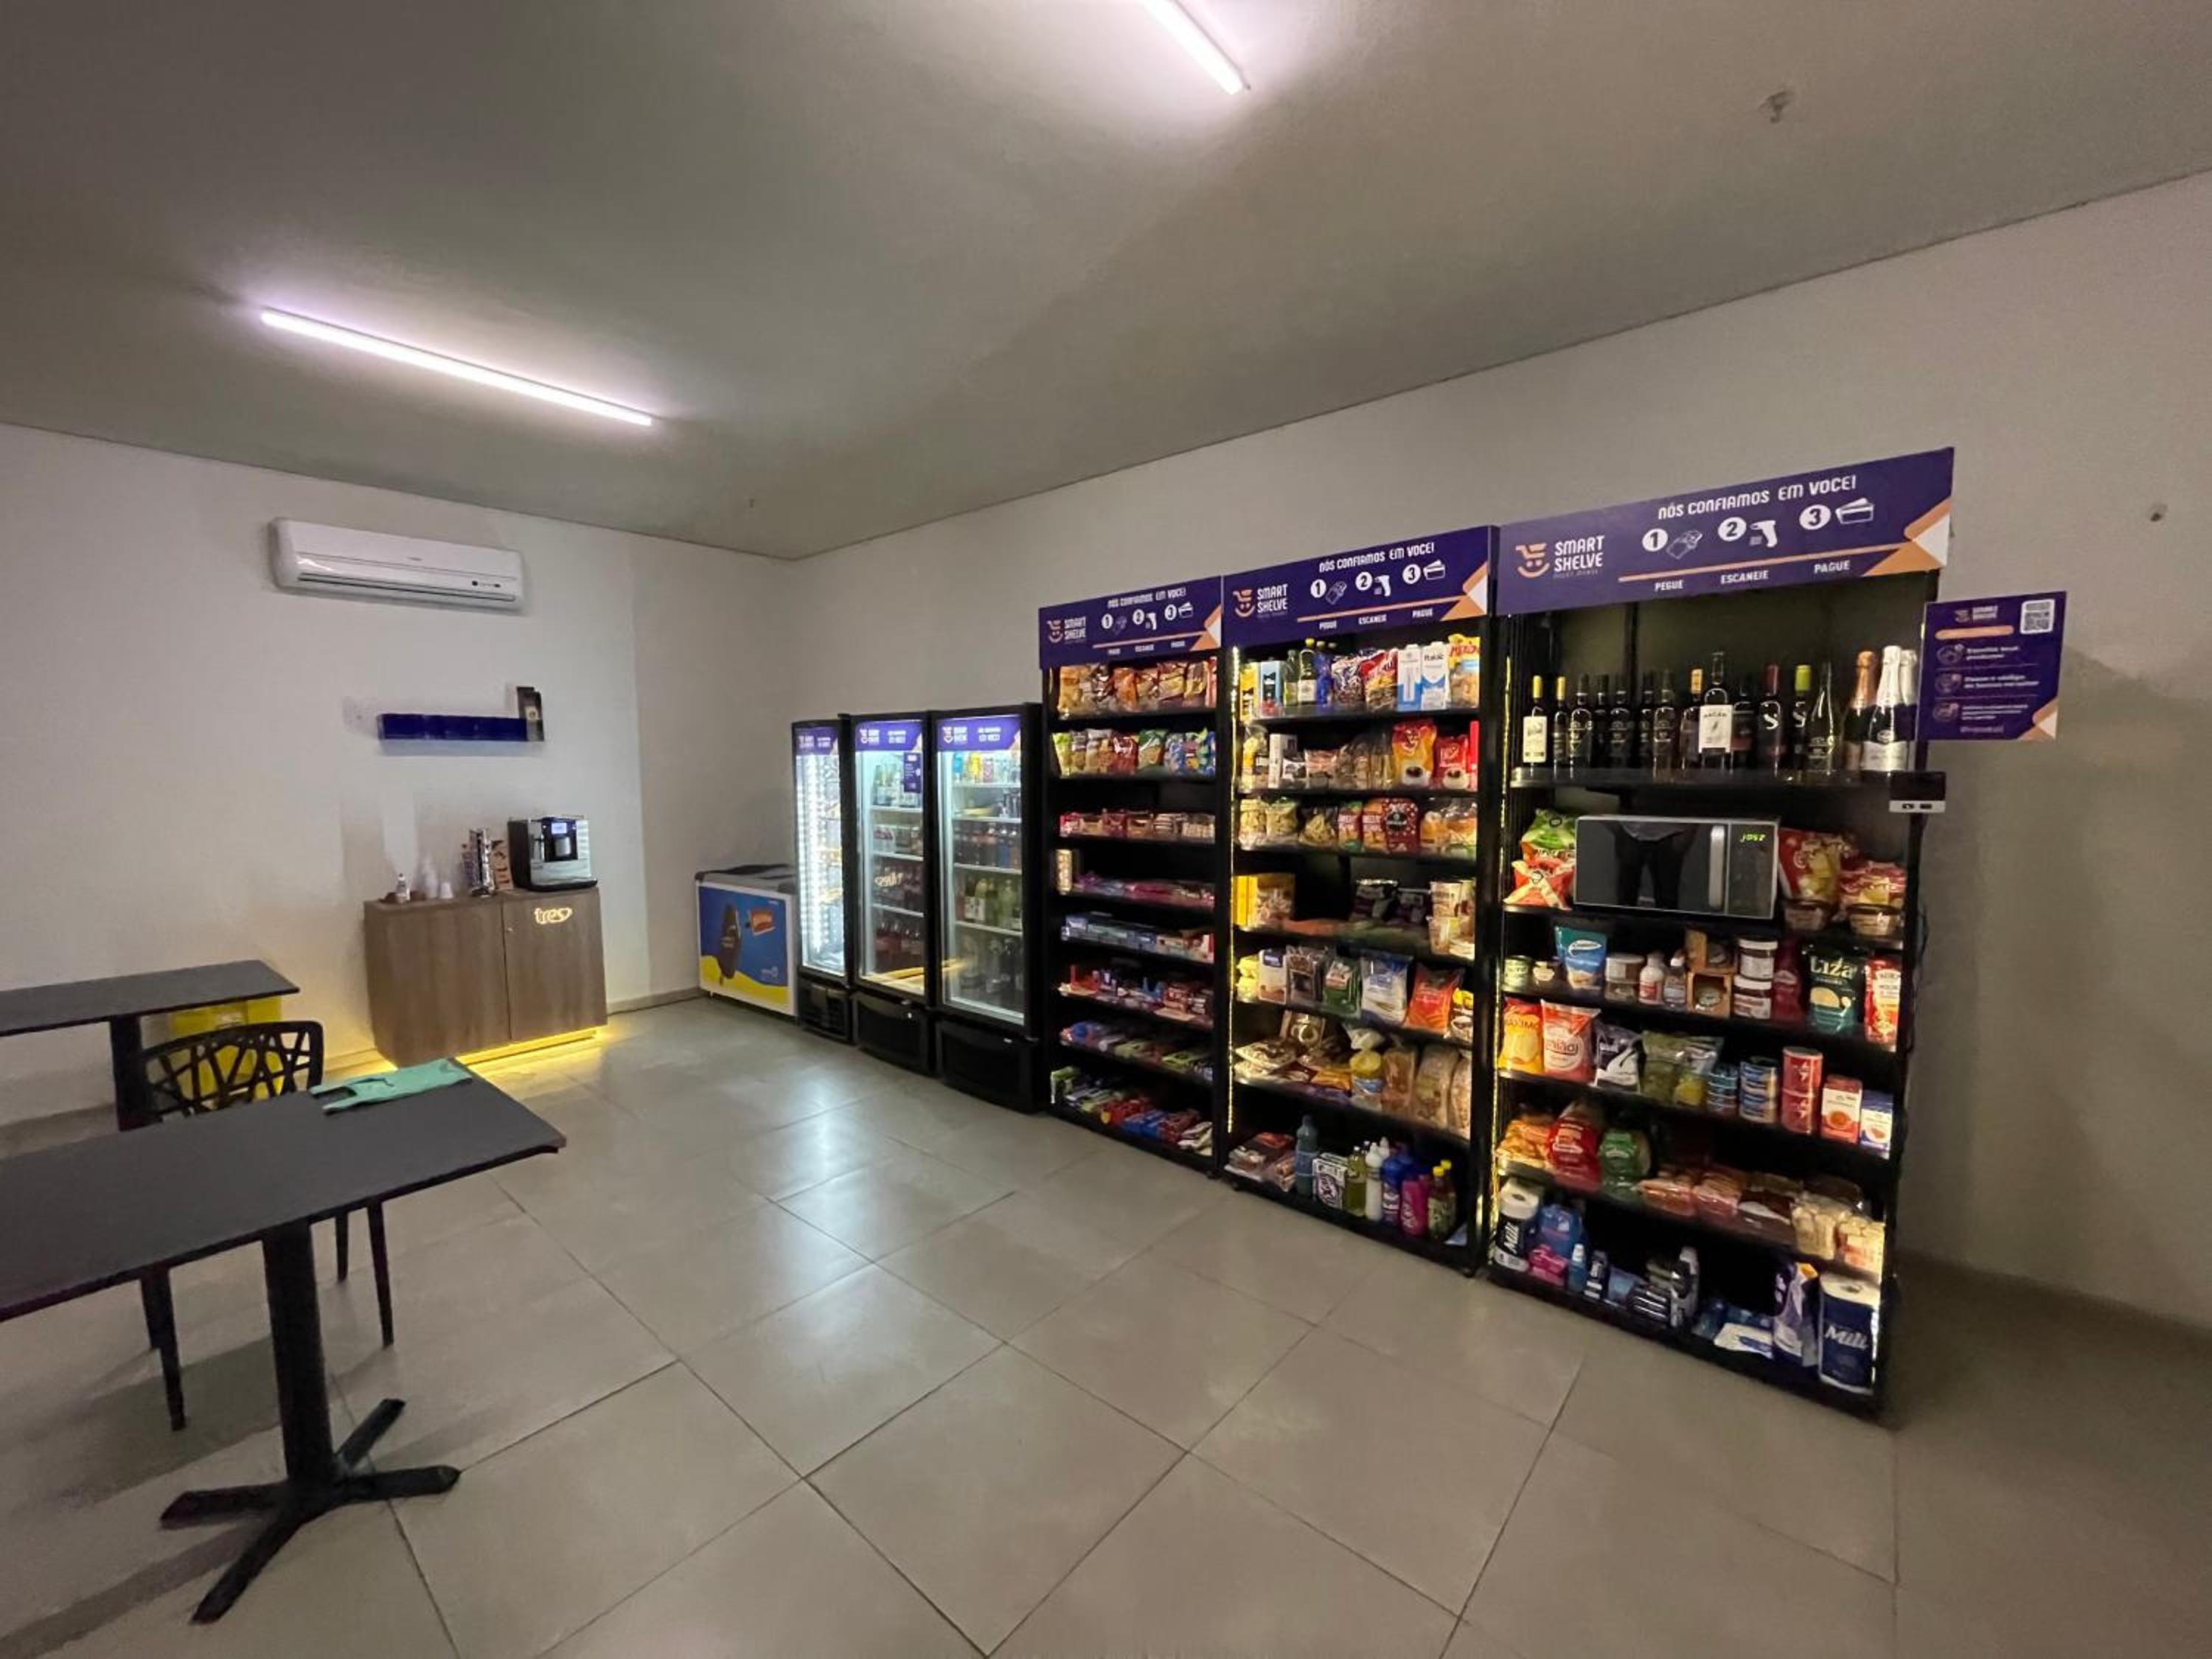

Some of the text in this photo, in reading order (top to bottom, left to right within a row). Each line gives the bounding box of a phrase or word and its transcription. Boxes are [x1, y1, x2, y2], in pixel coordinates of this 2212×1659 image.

[1658, 502, 1685, 520] NÓS
[1688, 490, 1770, 515] CONFIAMOS
[1778, 484, 1804, 501] EM
[1554, 535, 1604, 556] SMART
[1389, 548, 1404, 560] EM
[1554, 552, 1604, 573] SHELVE
[1814, 560, 1851, 574] PAGUE
[1720, 570, 1769, 585] ESCANEIE
[1257, 583, 1288, 600] SMART
[1655, 579, 1684, 592] PEGUE
[1257, 598, 1287, 613] SHELVE
